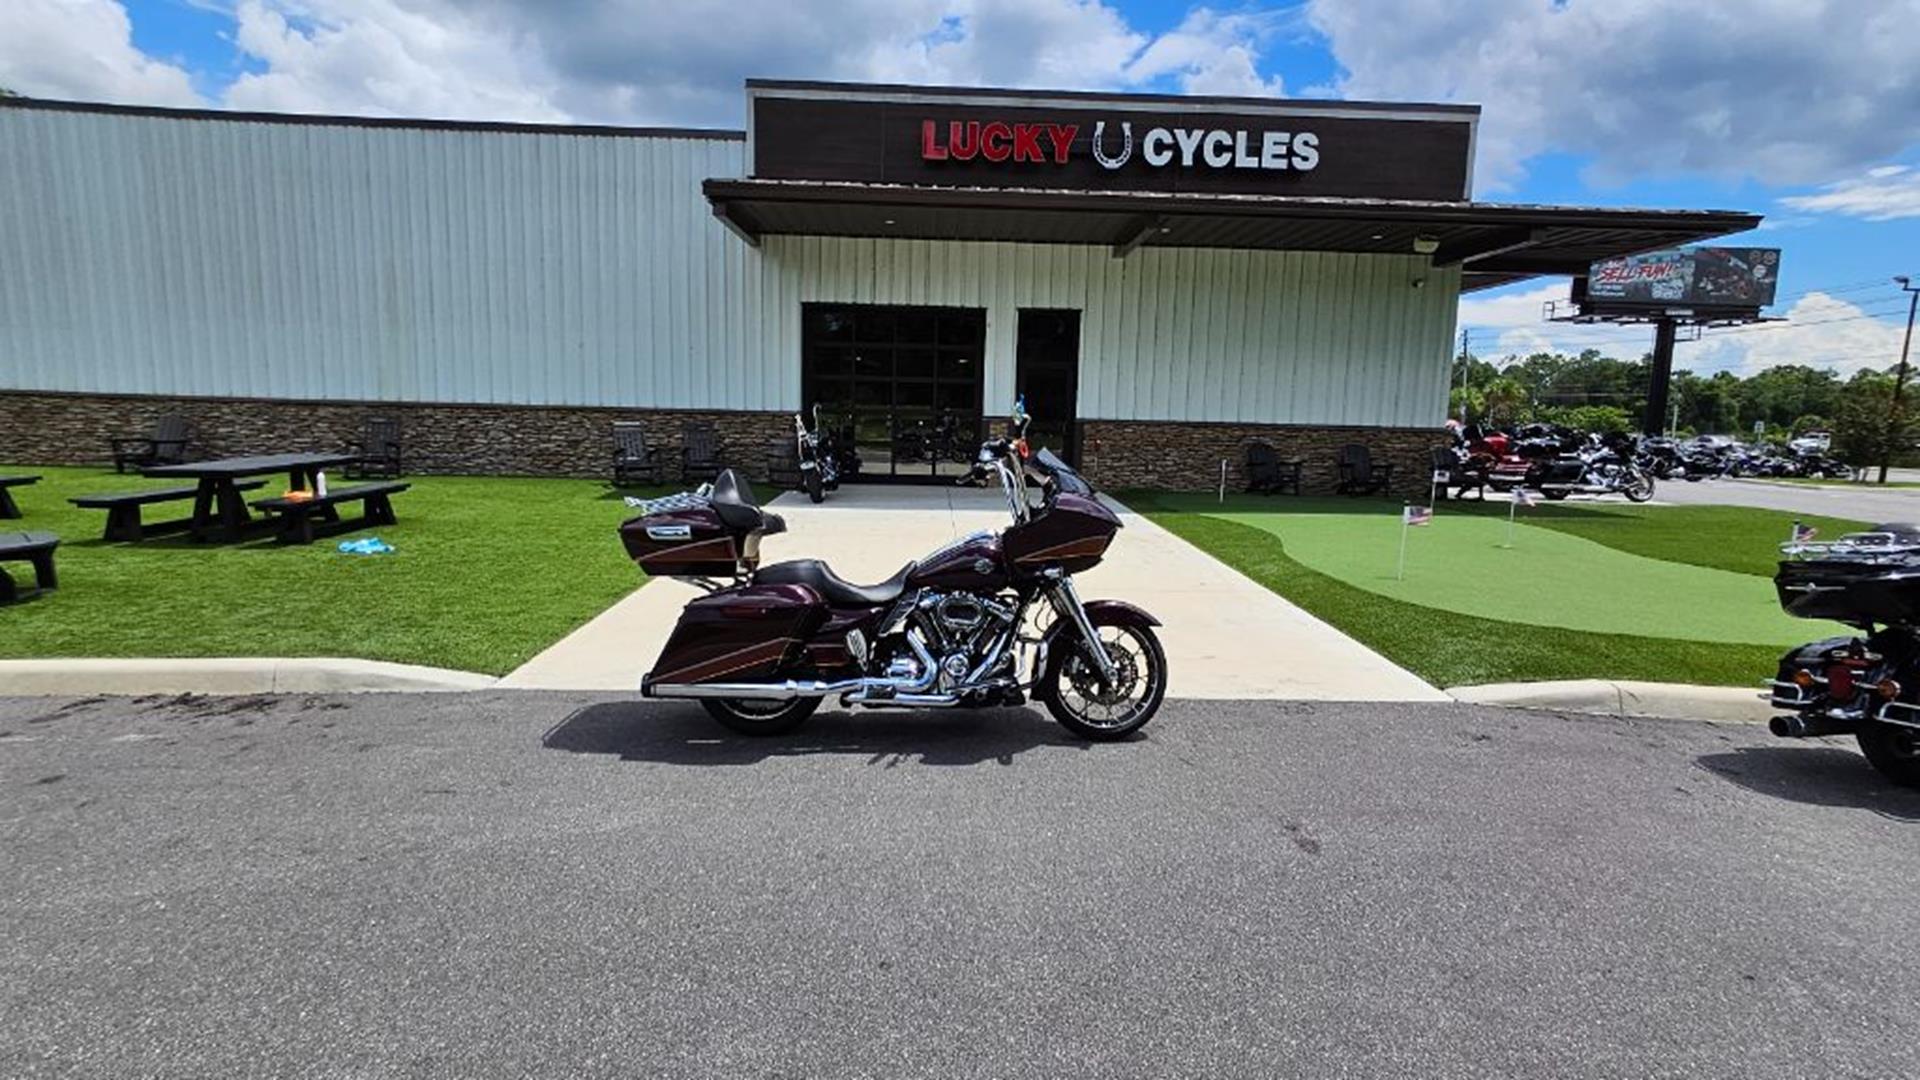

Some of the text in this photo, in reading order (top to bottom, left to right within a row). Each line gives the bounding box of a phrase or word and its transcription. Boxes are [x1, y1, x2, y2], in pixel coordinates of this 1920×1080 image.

[921, 119, 1320, 171] LUCKY CYCLES
[1598, 264, 1637, 282] SELL
